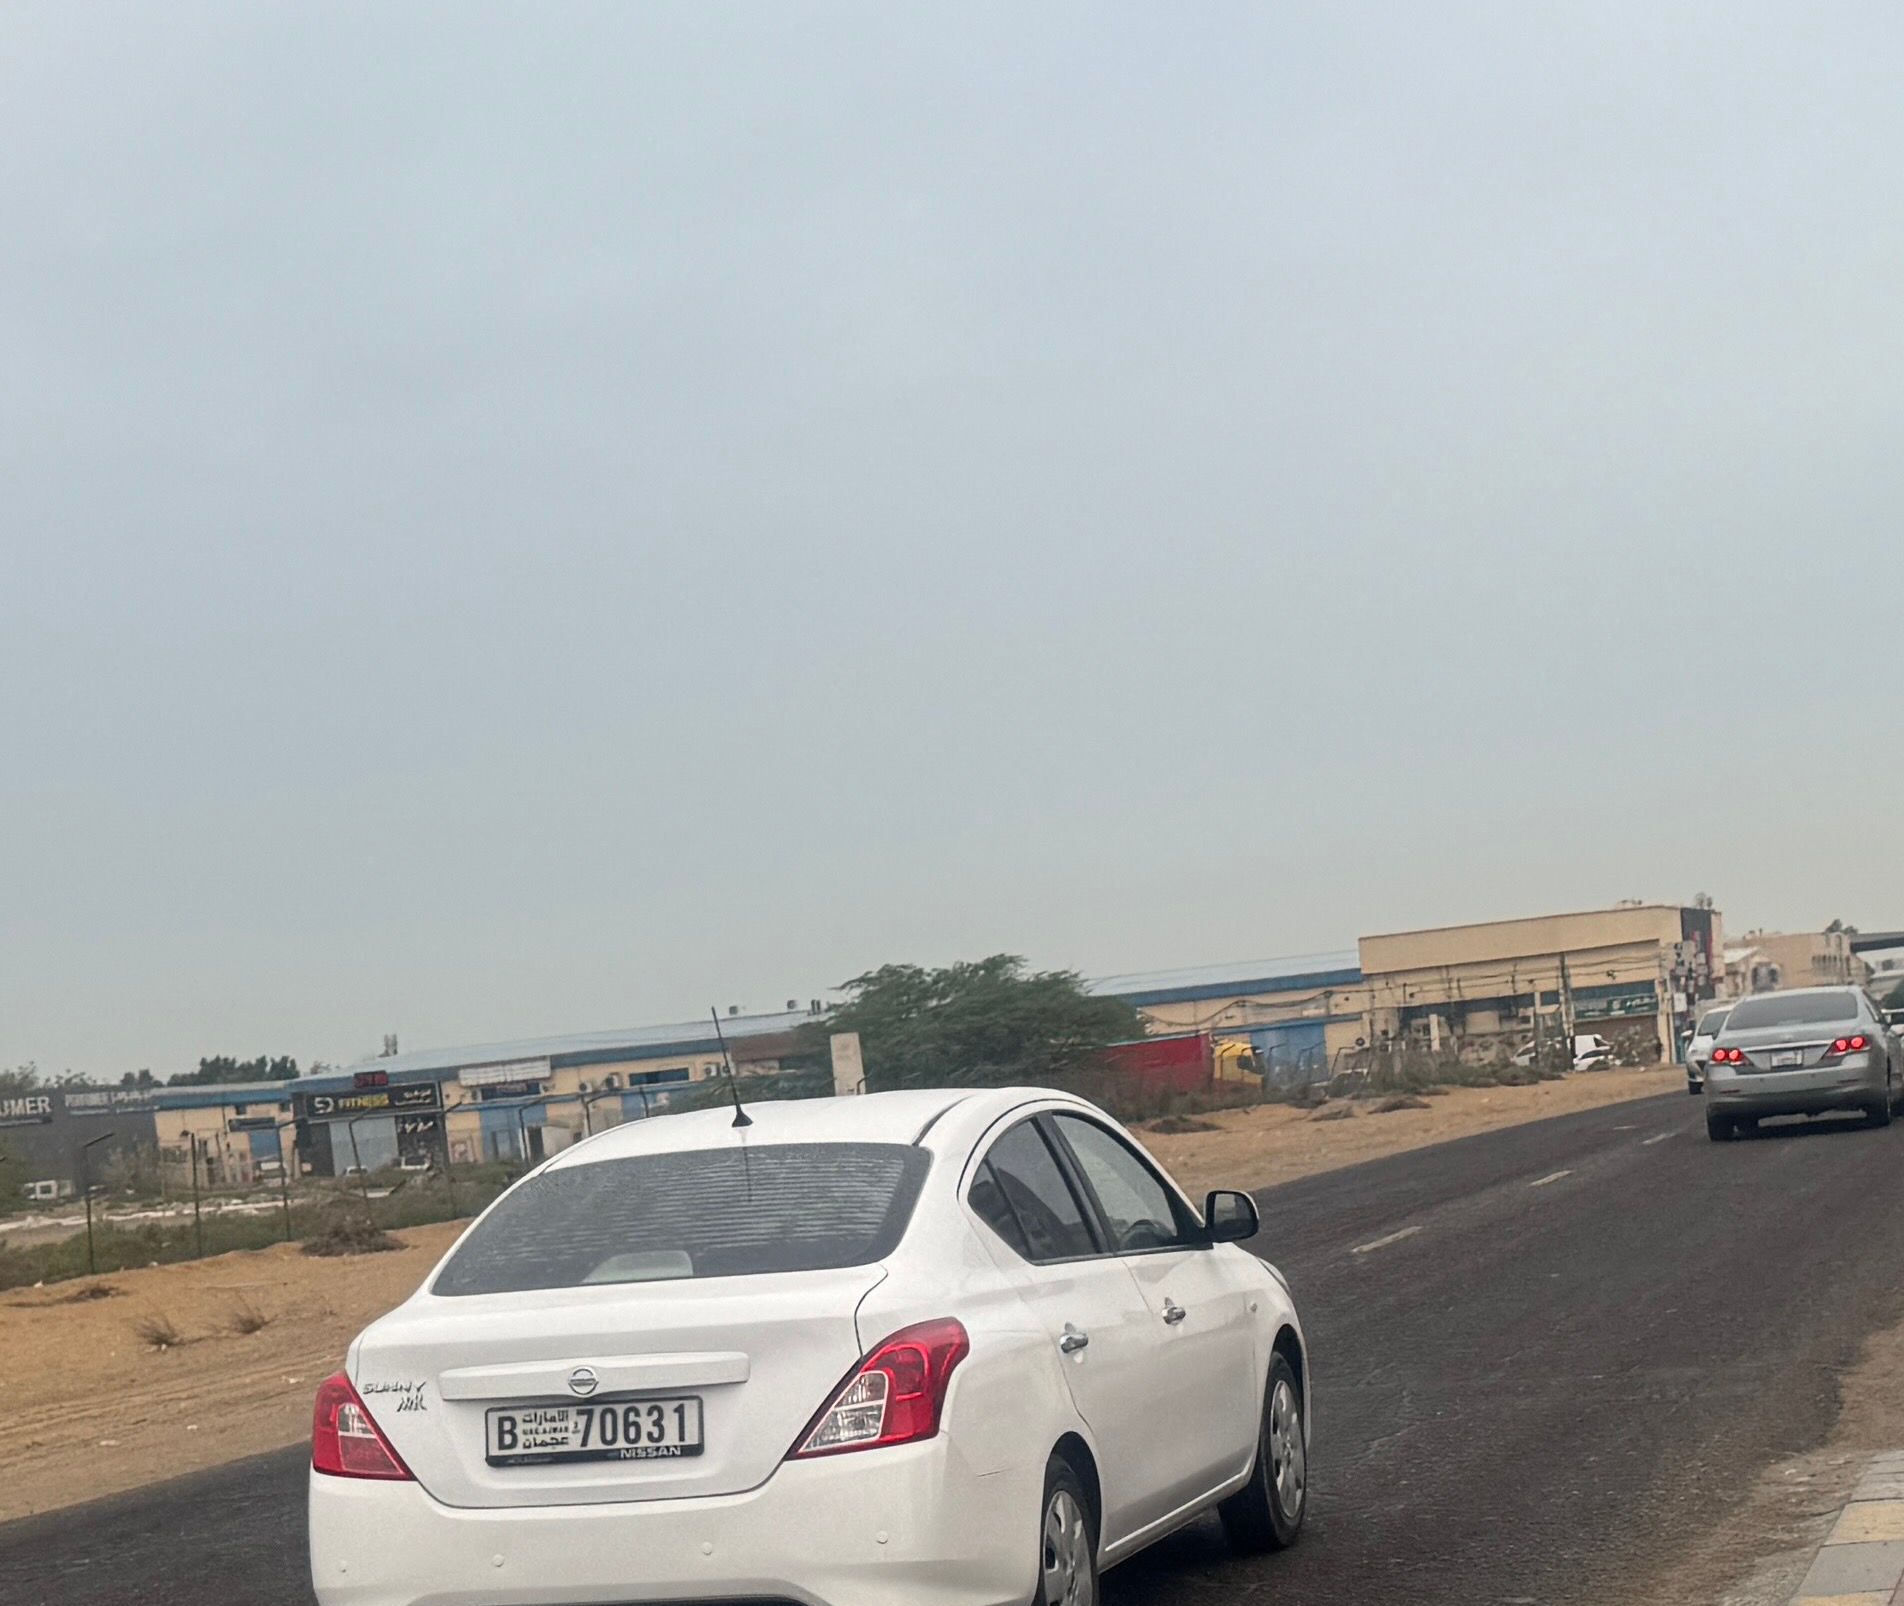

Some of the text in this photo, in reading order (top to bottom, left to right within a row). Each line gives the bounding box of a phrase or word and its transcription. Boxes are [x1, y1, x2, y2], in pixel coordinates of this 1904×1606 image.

[497, 1403, 686, 1450] B 70631
[522, 1436, 569, 1449] عجمان
[619, 1446, 682, 1459] NISSAN
